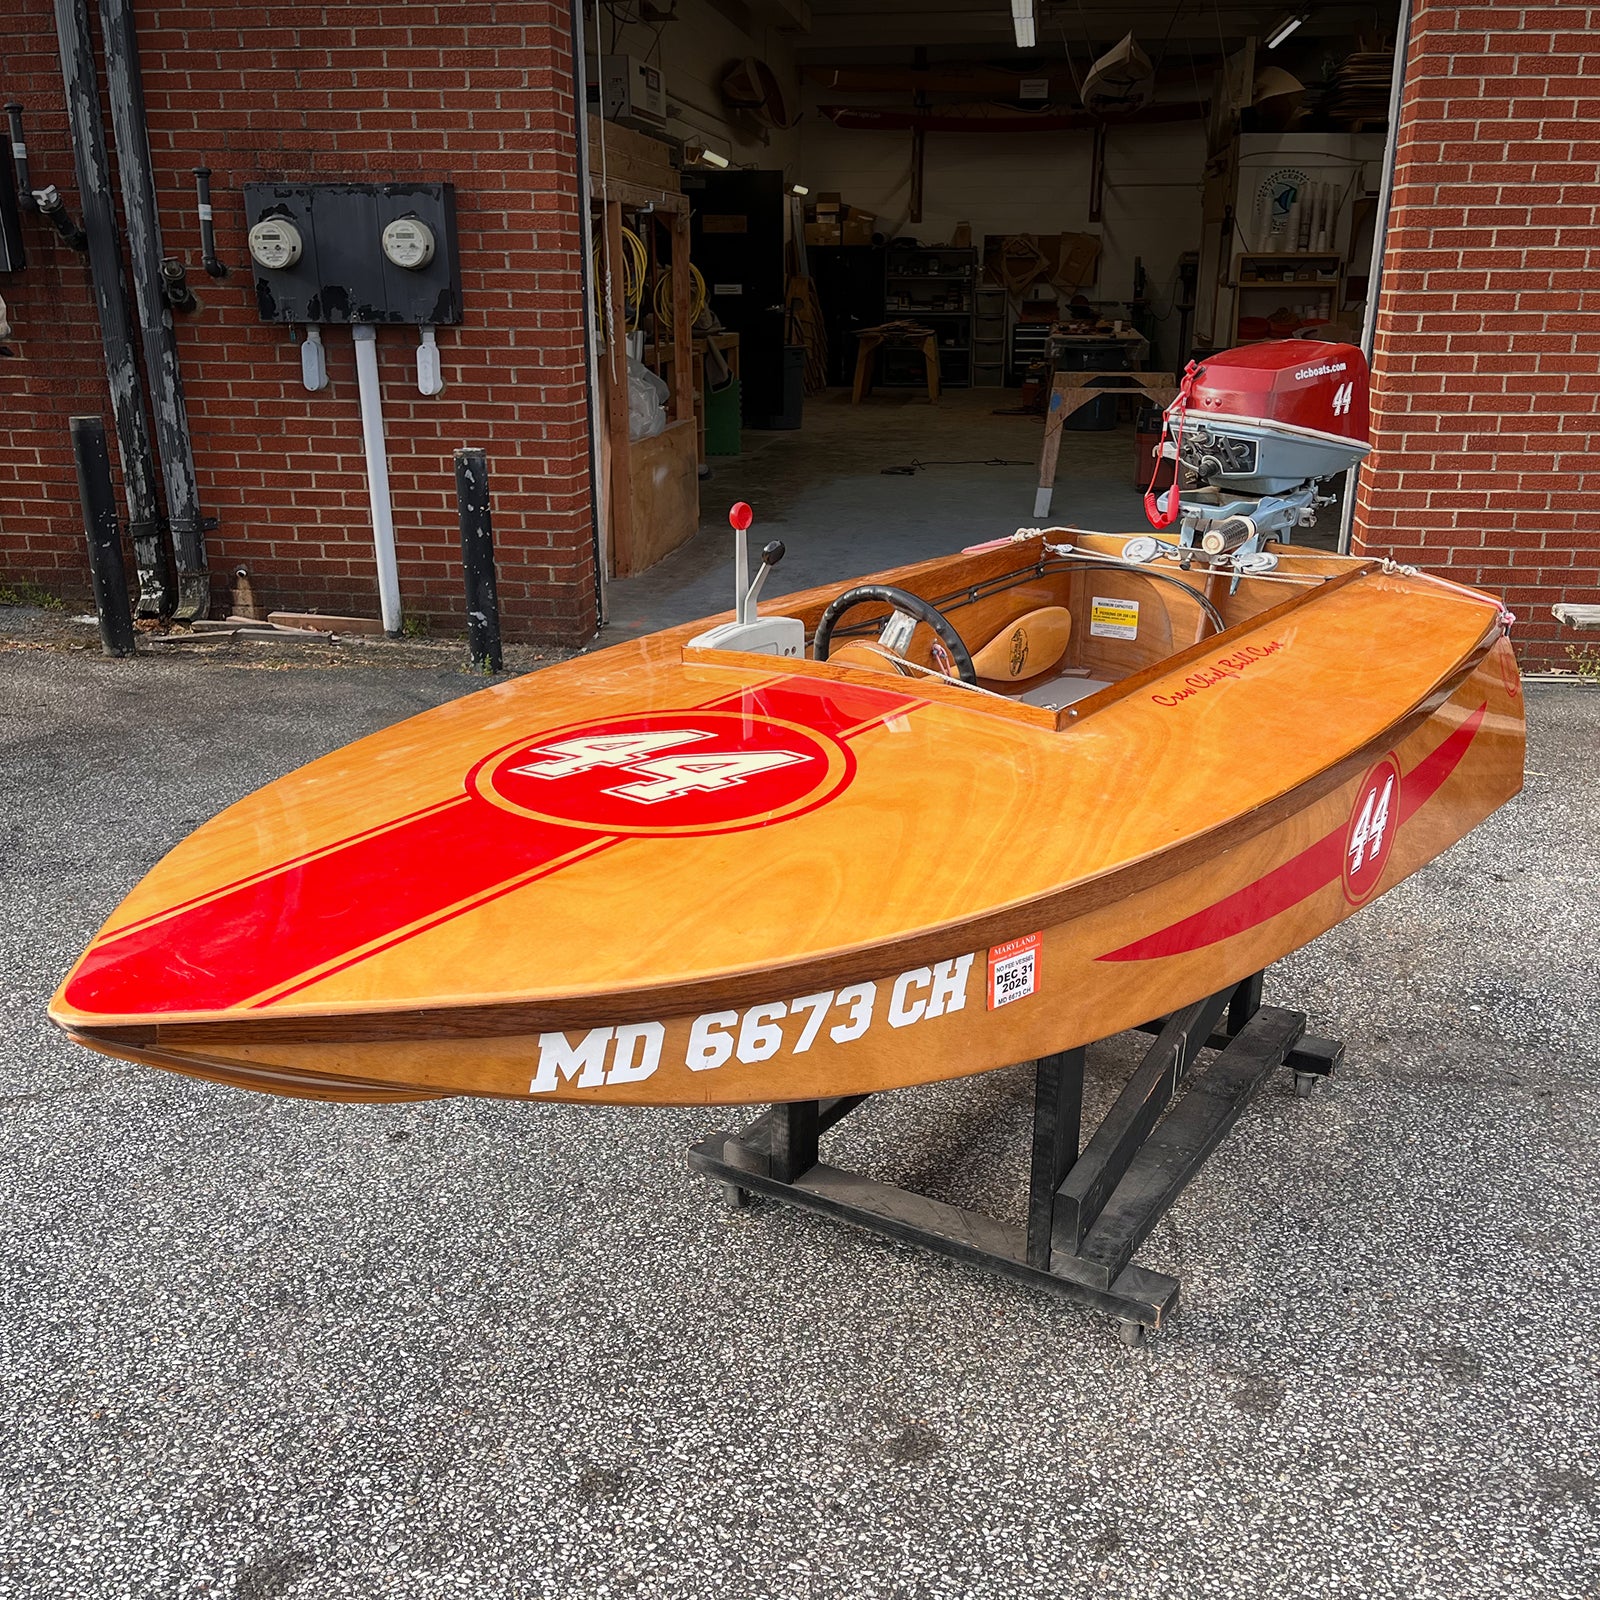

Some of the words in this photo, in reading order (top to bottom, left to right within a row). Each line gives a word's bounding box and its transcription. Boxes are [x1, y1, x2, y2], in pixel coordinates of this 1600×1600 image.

[1295, 362, 1347, 381] clcboats.com
[1331, 381, 1354, 417] 44
[1151, 687, 1198, 707] Crew
[1218, 651, 1260, 671] Bill
[507, 728, 815, 805] 44
[1348, 773, 1394, 876] 44
[994, 934, 1036, 956] MARYLAND
[996, 965, 1004, 973] NO
[1005, 961, 1015, 969] FEE
[1015, 954, 1034, 966] VESSEL
[996, 969, 1018, 985] DEC
[1021, 963, 1033, 975] 31
[998, 996, 1007, 1004] MD
[1008, 991, 1021, 1000] 6673
[1022, 987, 1031, 995] CH
[1002, 976, 1028, 993] 2026
[529, 1021, 666, 1094] MD
[685, 981, 877, 1072] 6673
[888, 952, 976, 1029] CH
